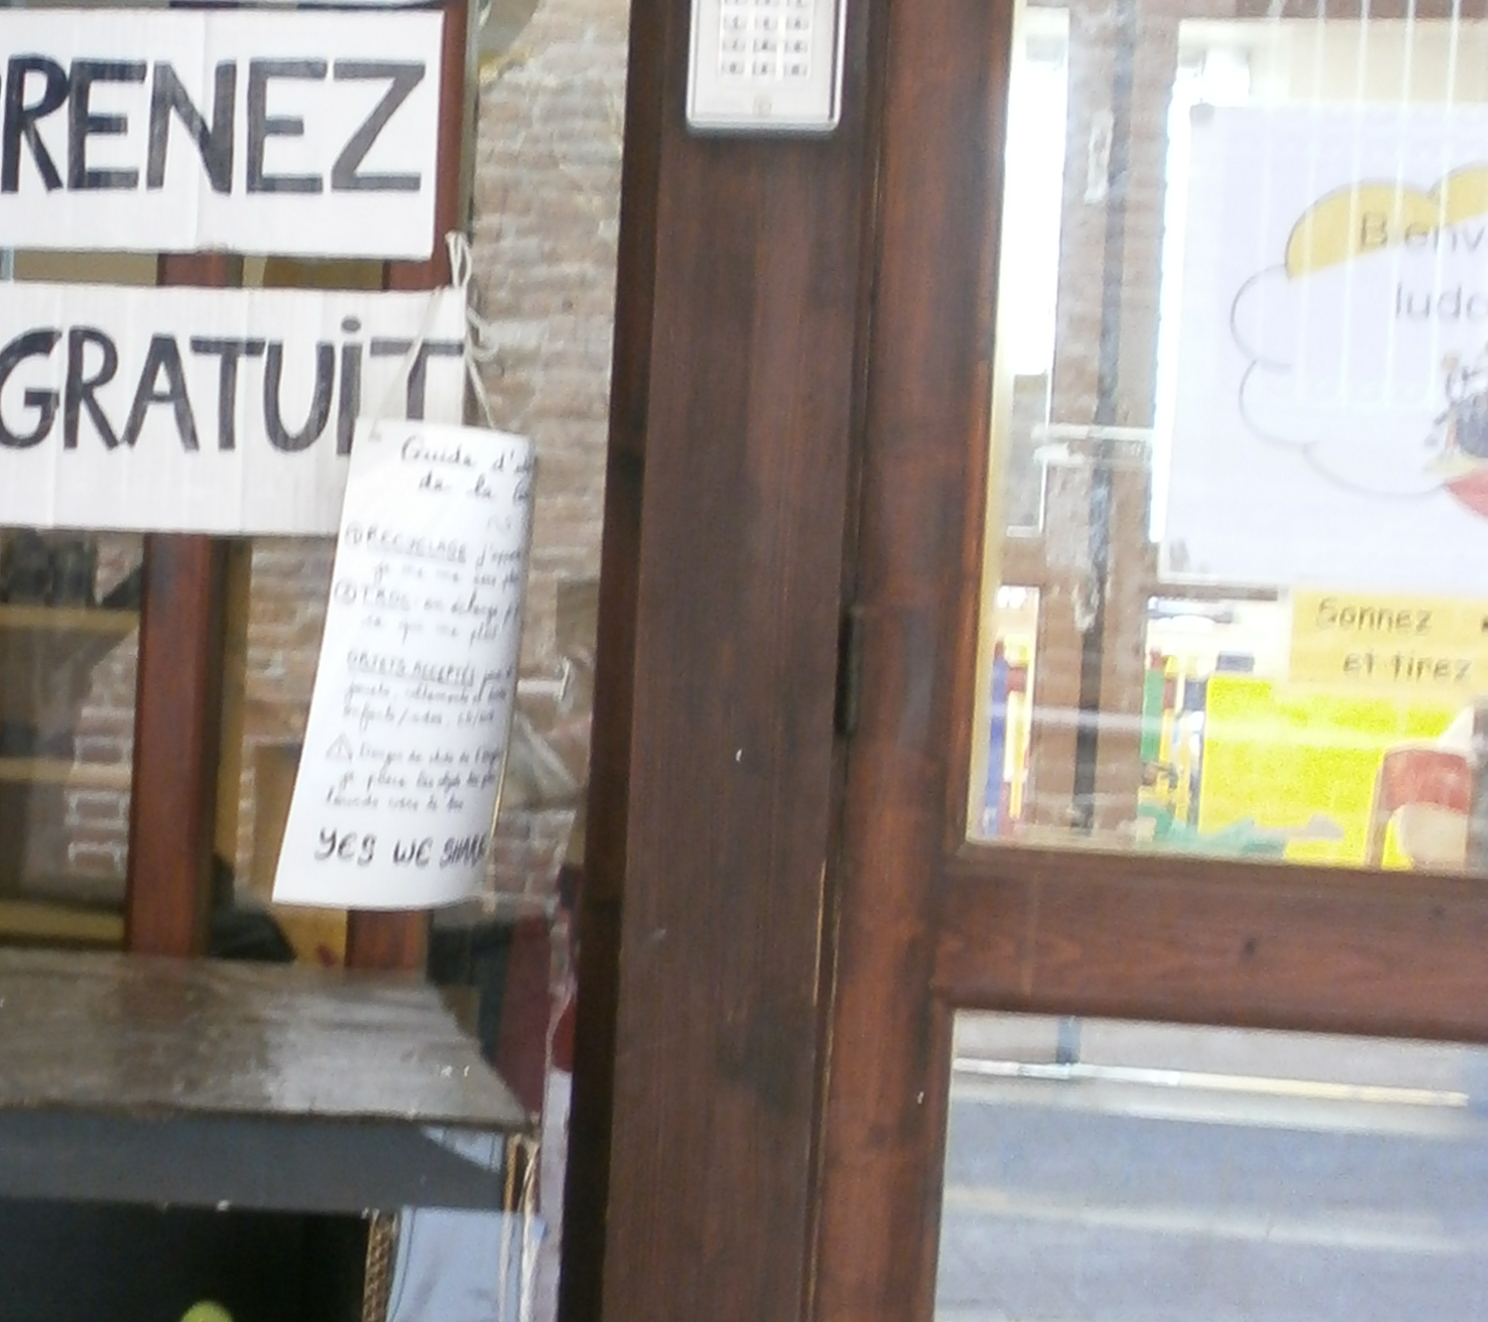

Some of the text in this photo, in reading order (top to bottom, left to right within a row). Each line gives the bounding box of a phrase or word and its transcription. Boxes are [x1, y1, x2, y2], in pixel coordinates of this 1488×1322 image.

[1316, 596, 1433, 636] Sonnez
[1343, 648, 1472, 682] et tirez
[314, 827, 378, 868] YES
[391, 834, 434, 868] WE
